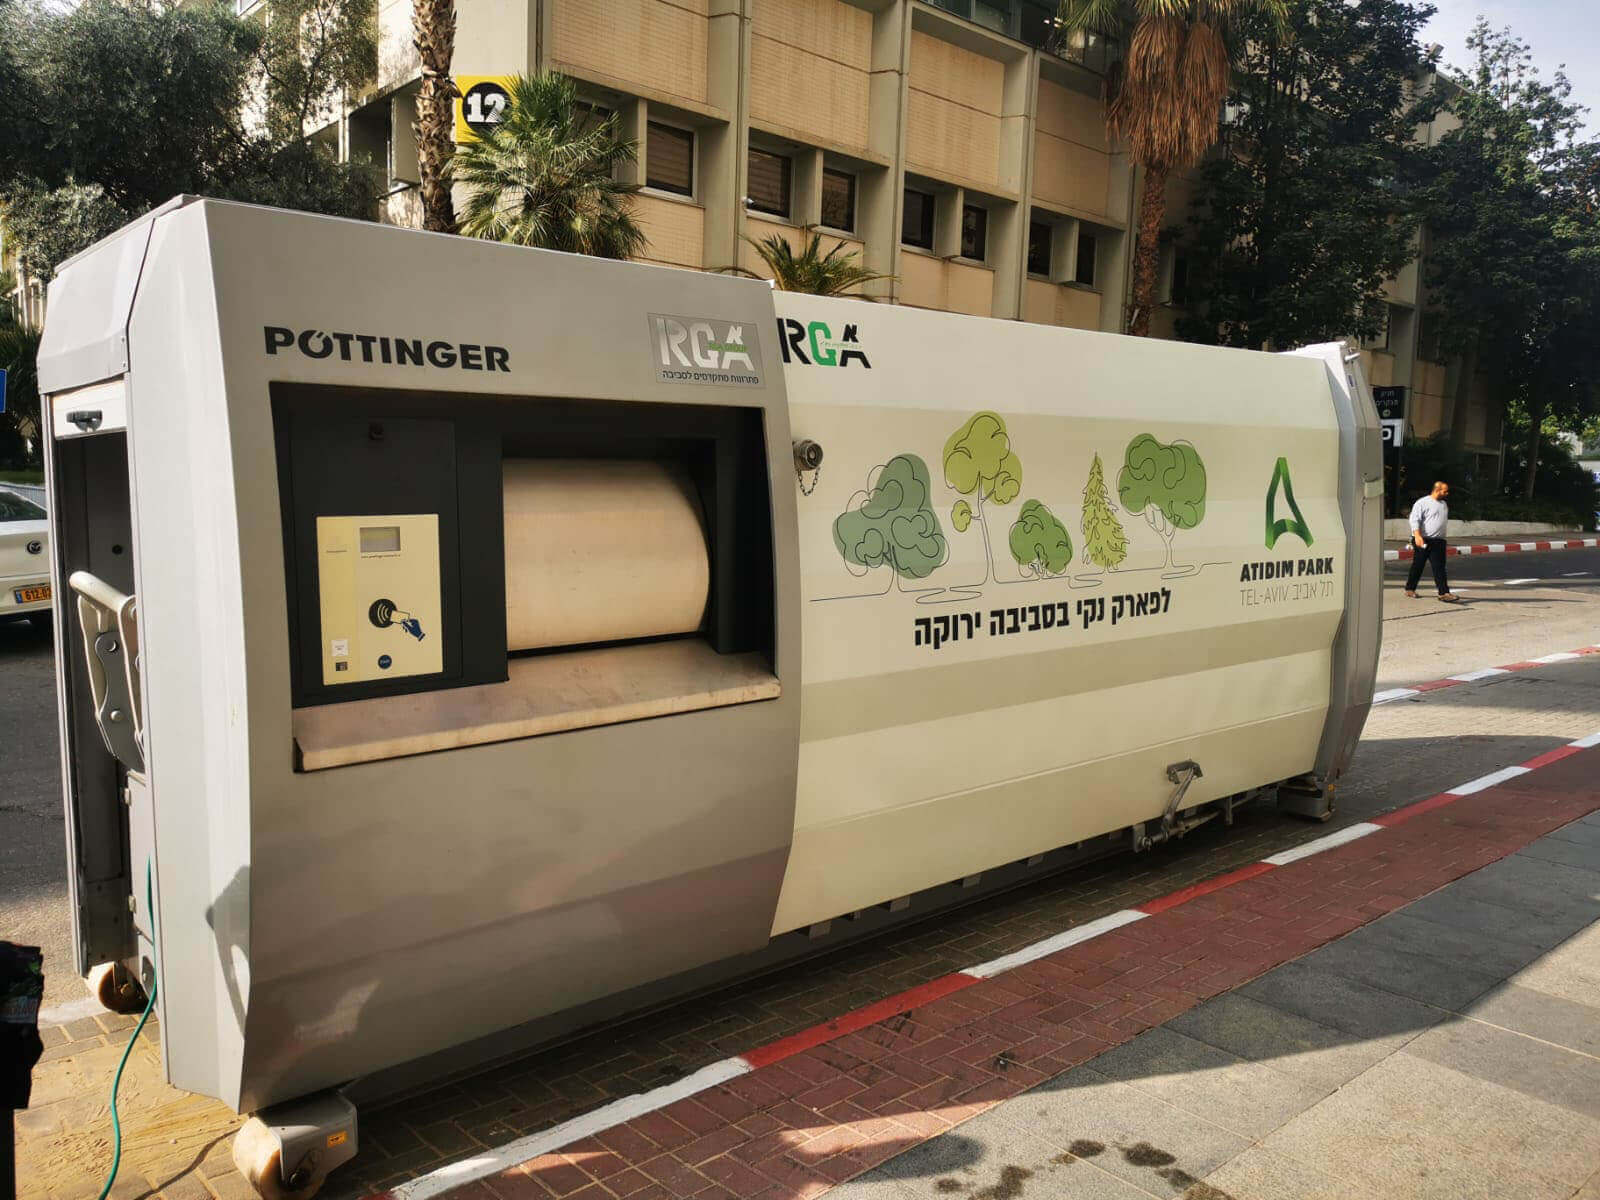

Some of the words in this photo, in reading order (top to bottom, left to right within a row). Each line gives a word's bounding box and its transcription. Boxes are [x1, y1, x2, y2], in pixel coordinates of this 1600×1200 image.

[467, 92, 506, 123] 12
[662, 370, 692, 380] לסביבה
[694, 372, 730, 383] מתקדמים
[1240, 560, 1294, 582] ATIDIM
[1298, 557, 1334, 577] PARK
[1240, 585, 1289, 607] TEL-AVIV
[1292, 584, 1318, 601] אביב
[1320, 580, 1334, 598] תל
[1077, 598, 1105, 629] נקי
[1111, 587, 1171, 625] לפארק
[914, 612, 981, 650] ירוקה
[990, 602, 1070, 636] בסביבה
